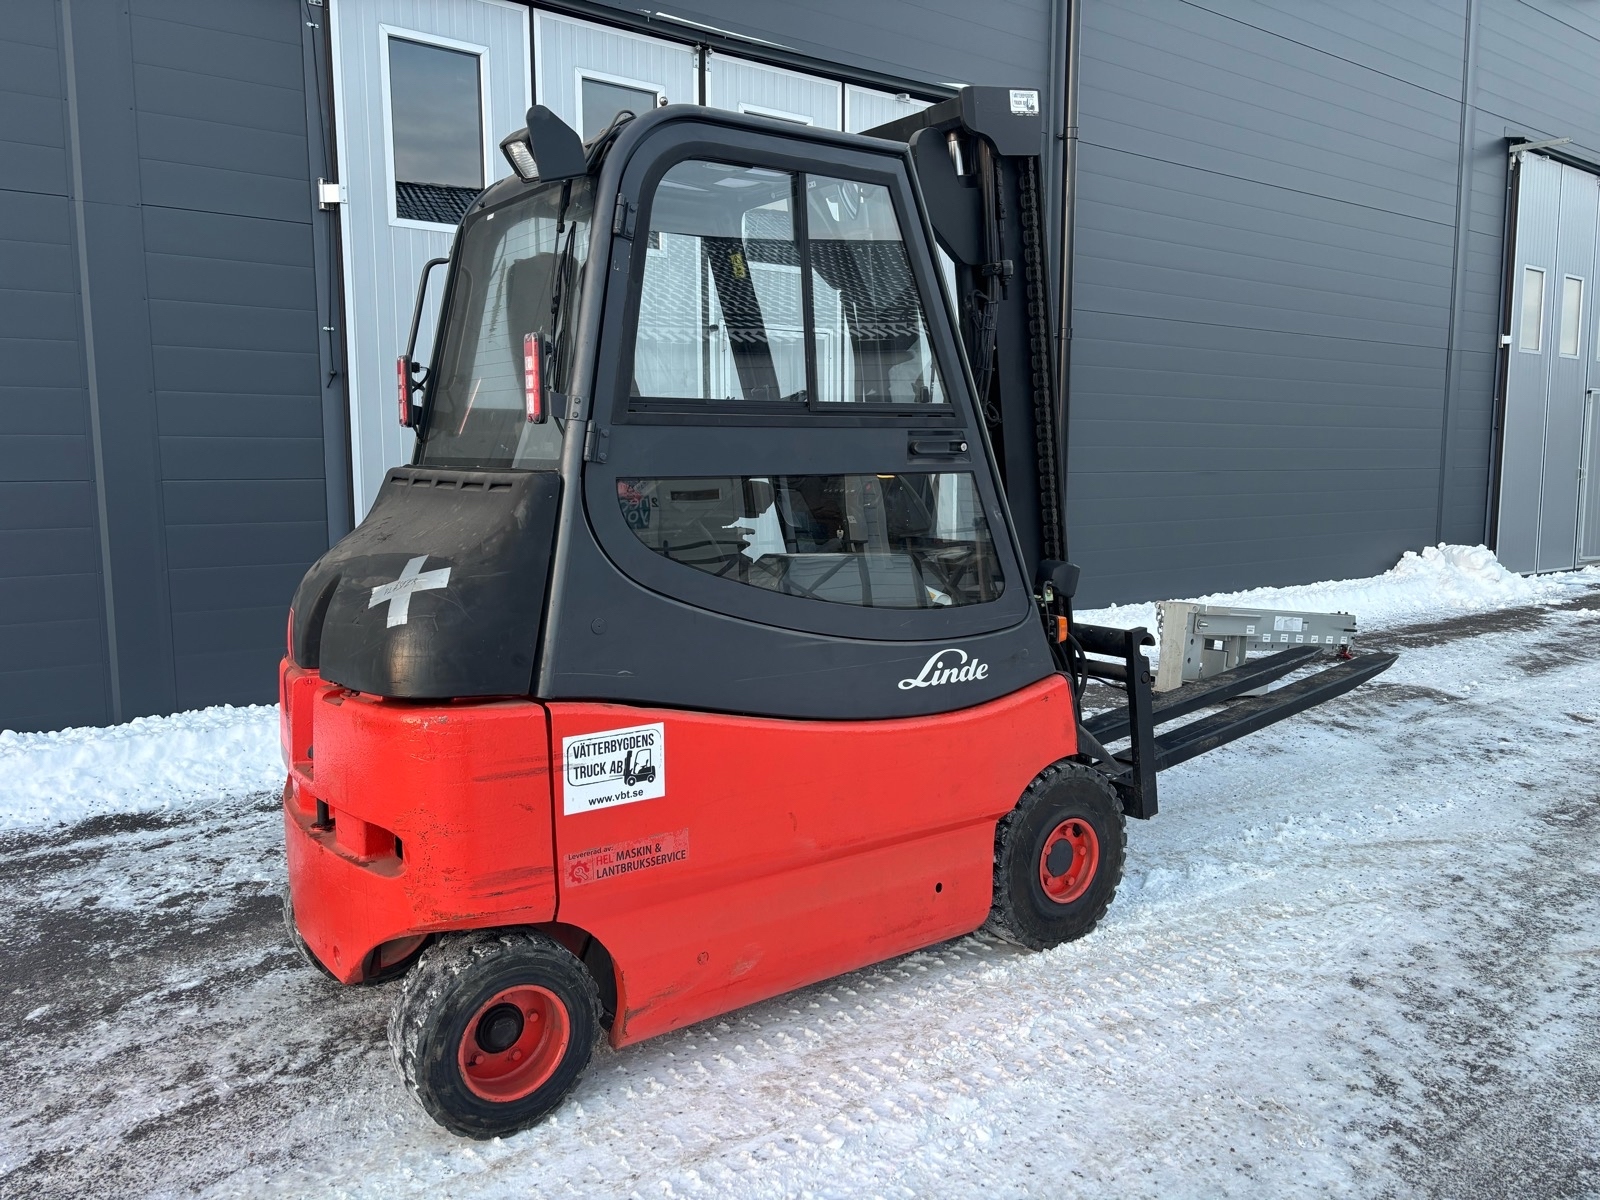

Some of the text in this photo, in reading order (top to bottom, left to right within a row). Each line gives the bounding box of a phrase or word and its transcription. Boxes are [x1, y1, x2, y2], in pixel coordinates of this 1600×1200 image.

[898, 648, 989, 690] Linde
[573, 733, 655, 760] VÄTTERBYGDENS
[573, 760, 624, 780] TRUCK AB
[588, 789, 644, 806] www.vbt.se
[568, 845, 614, 861] Levererad av:
[596, 843, 662, 866] HEL MASKIN &
[596, 849, 686, 879] LANTBRUKSSERVICE
